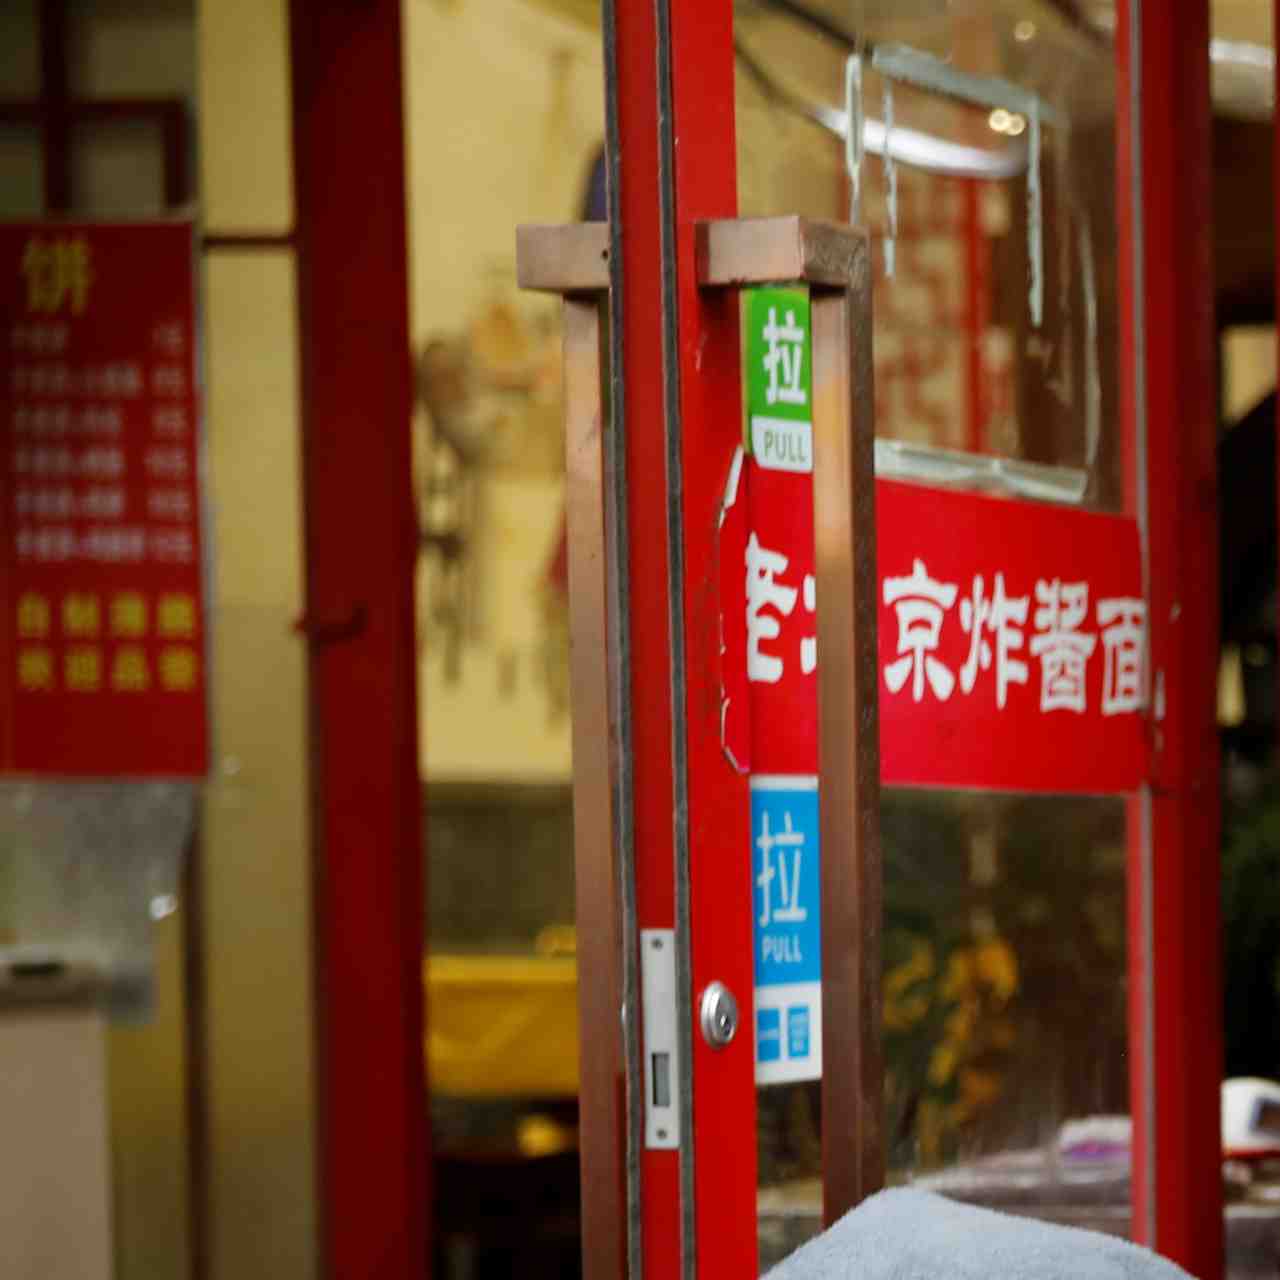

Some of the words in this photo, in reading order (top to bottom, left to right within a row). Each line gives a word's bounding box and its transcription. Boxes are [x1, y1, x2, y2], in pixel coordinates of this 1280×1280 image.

[763, 307, 807, 405] 拉
[763, 430, 807, 463] PULL
[756, 811, 807, 927] 拉
[762, 934, 803, 964] PULL
